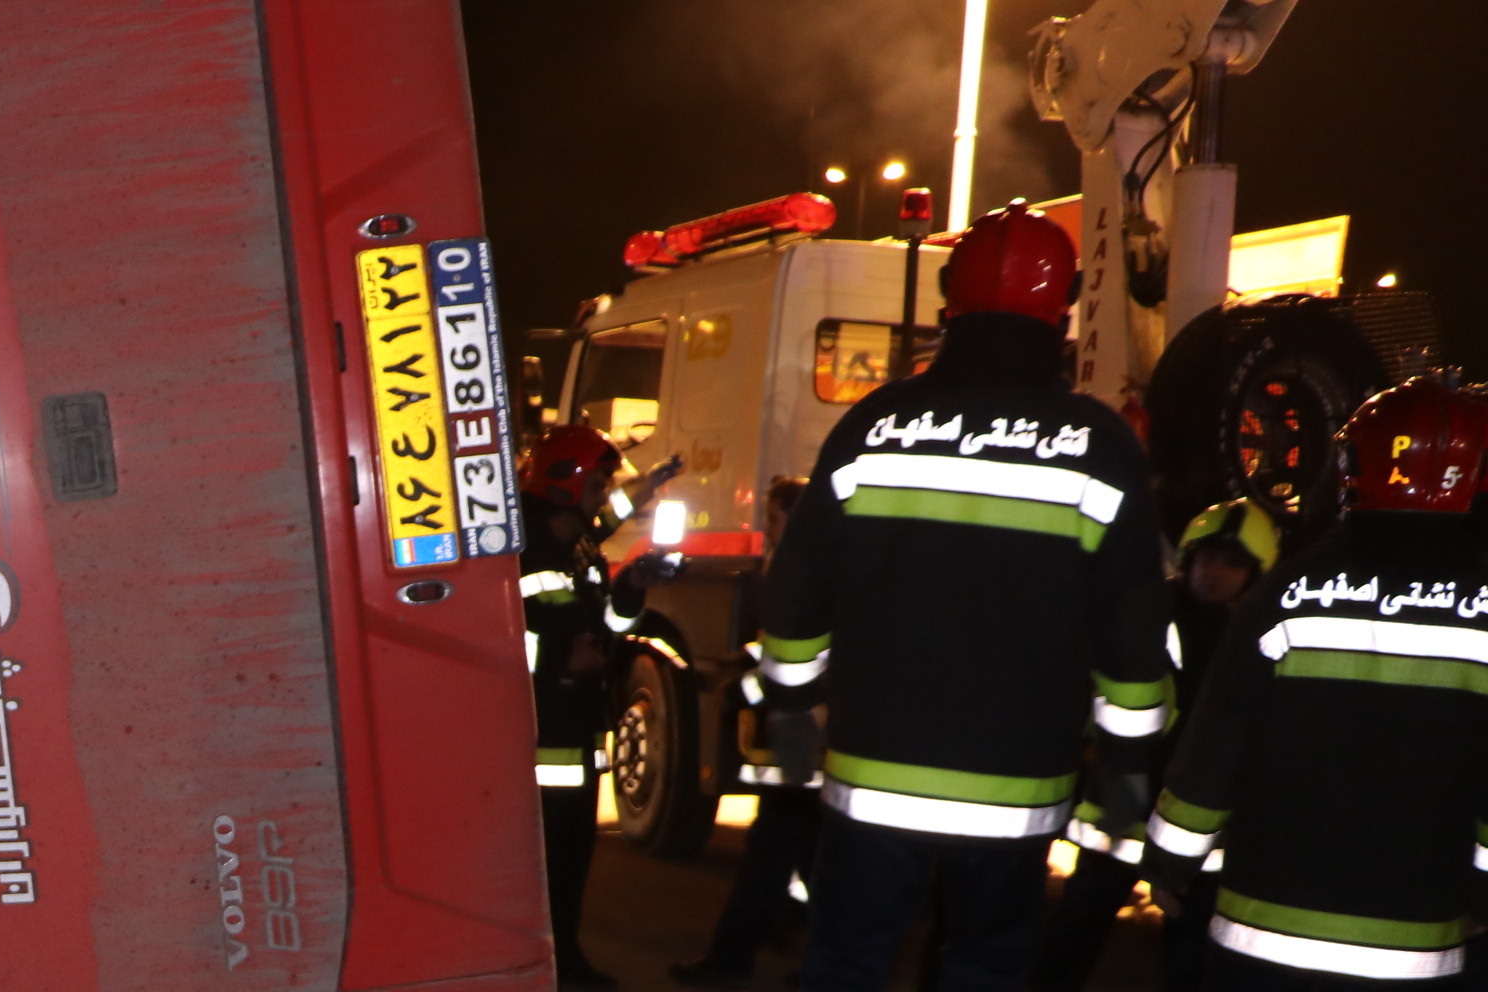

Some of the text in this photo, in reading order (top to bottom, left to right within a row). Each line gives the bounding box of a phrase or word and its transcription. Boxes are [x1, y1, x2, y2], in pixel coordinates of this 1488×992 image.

[378, 256, 420, 311] ۲۲
[437, 247, 498, 520] 73 E 861 10
[478, 242, 521, 548] Touring & Automobile Club of the Islamic Republic of IRAN
[864, 409, 963, 449] اصفهان
[443, 534, 454, 559] IRAN
[467, 528, 479, 556] IRAN
[1280, 571, 1379, 610] اصفهان
[214, 815, 249, 972] VOLVO
